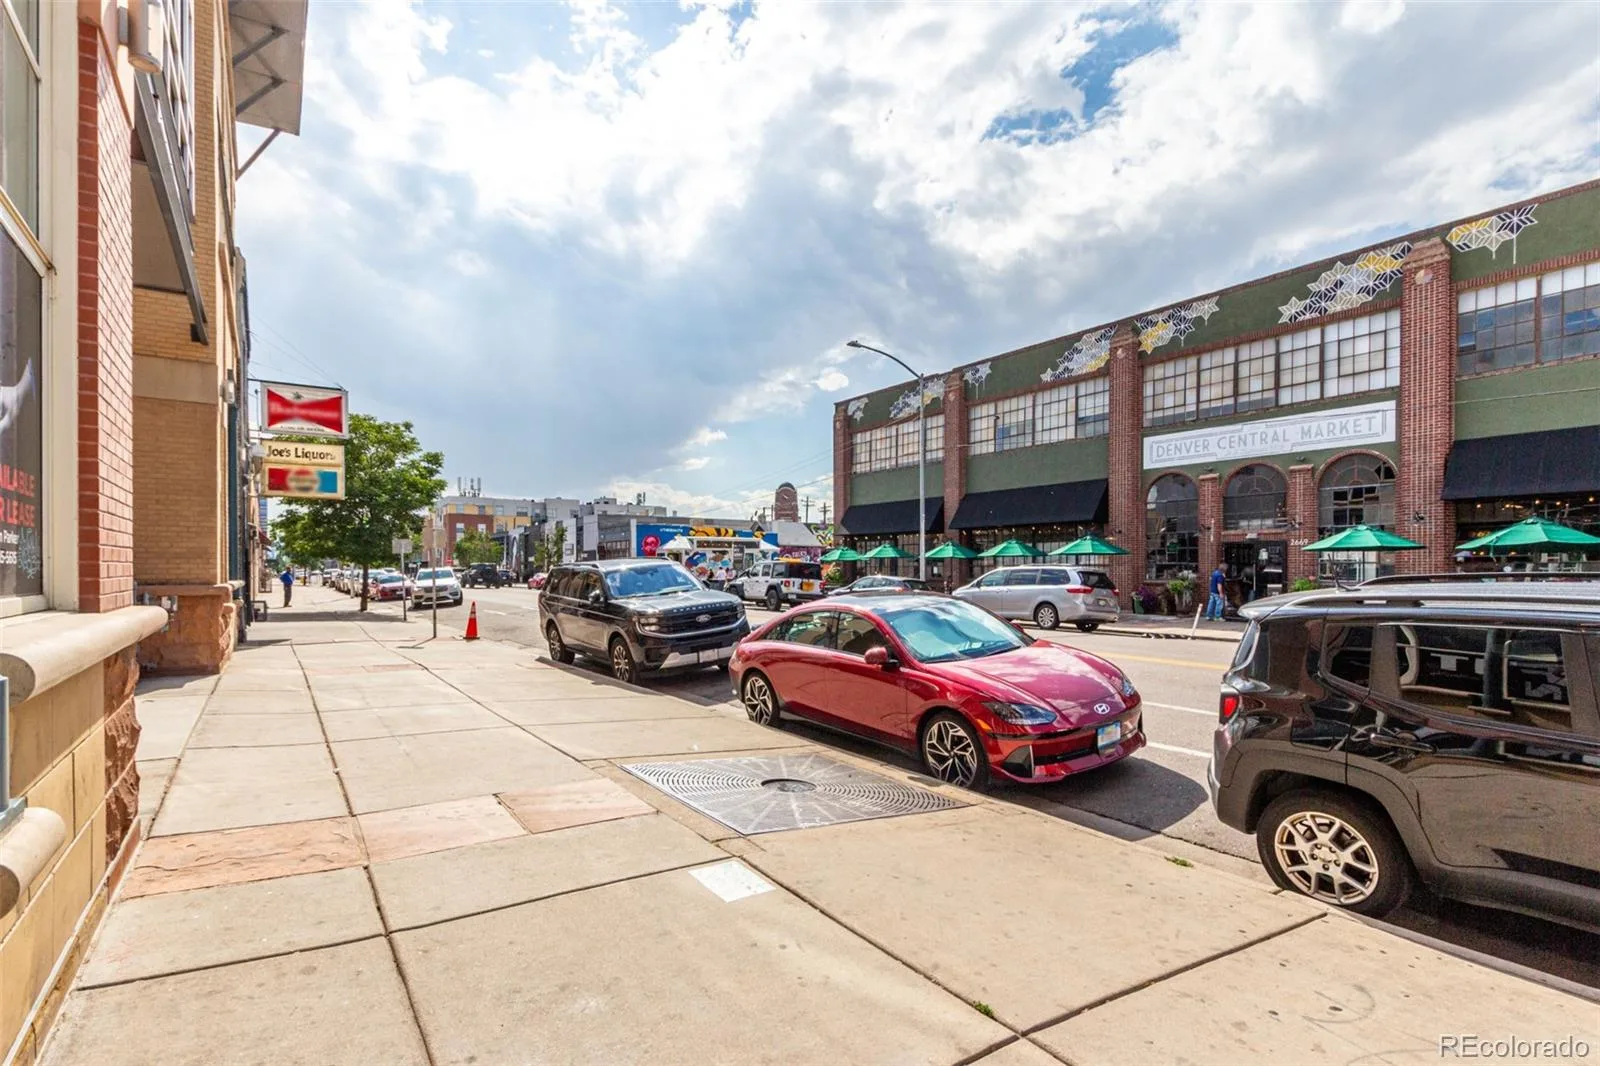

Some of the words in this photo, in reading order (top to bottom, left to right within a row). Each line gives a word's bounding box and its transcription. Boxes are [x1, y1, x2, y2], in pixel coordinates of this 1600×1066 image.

[1156, 438, 1210, 458] DENVER
[1217, 428, 1290, 449] CENTRAL
[1301, 416, 1376, 440] MARKET
[266, 445, 291, 458] Joe's
[1290, 538, 1308, 546] 2669
